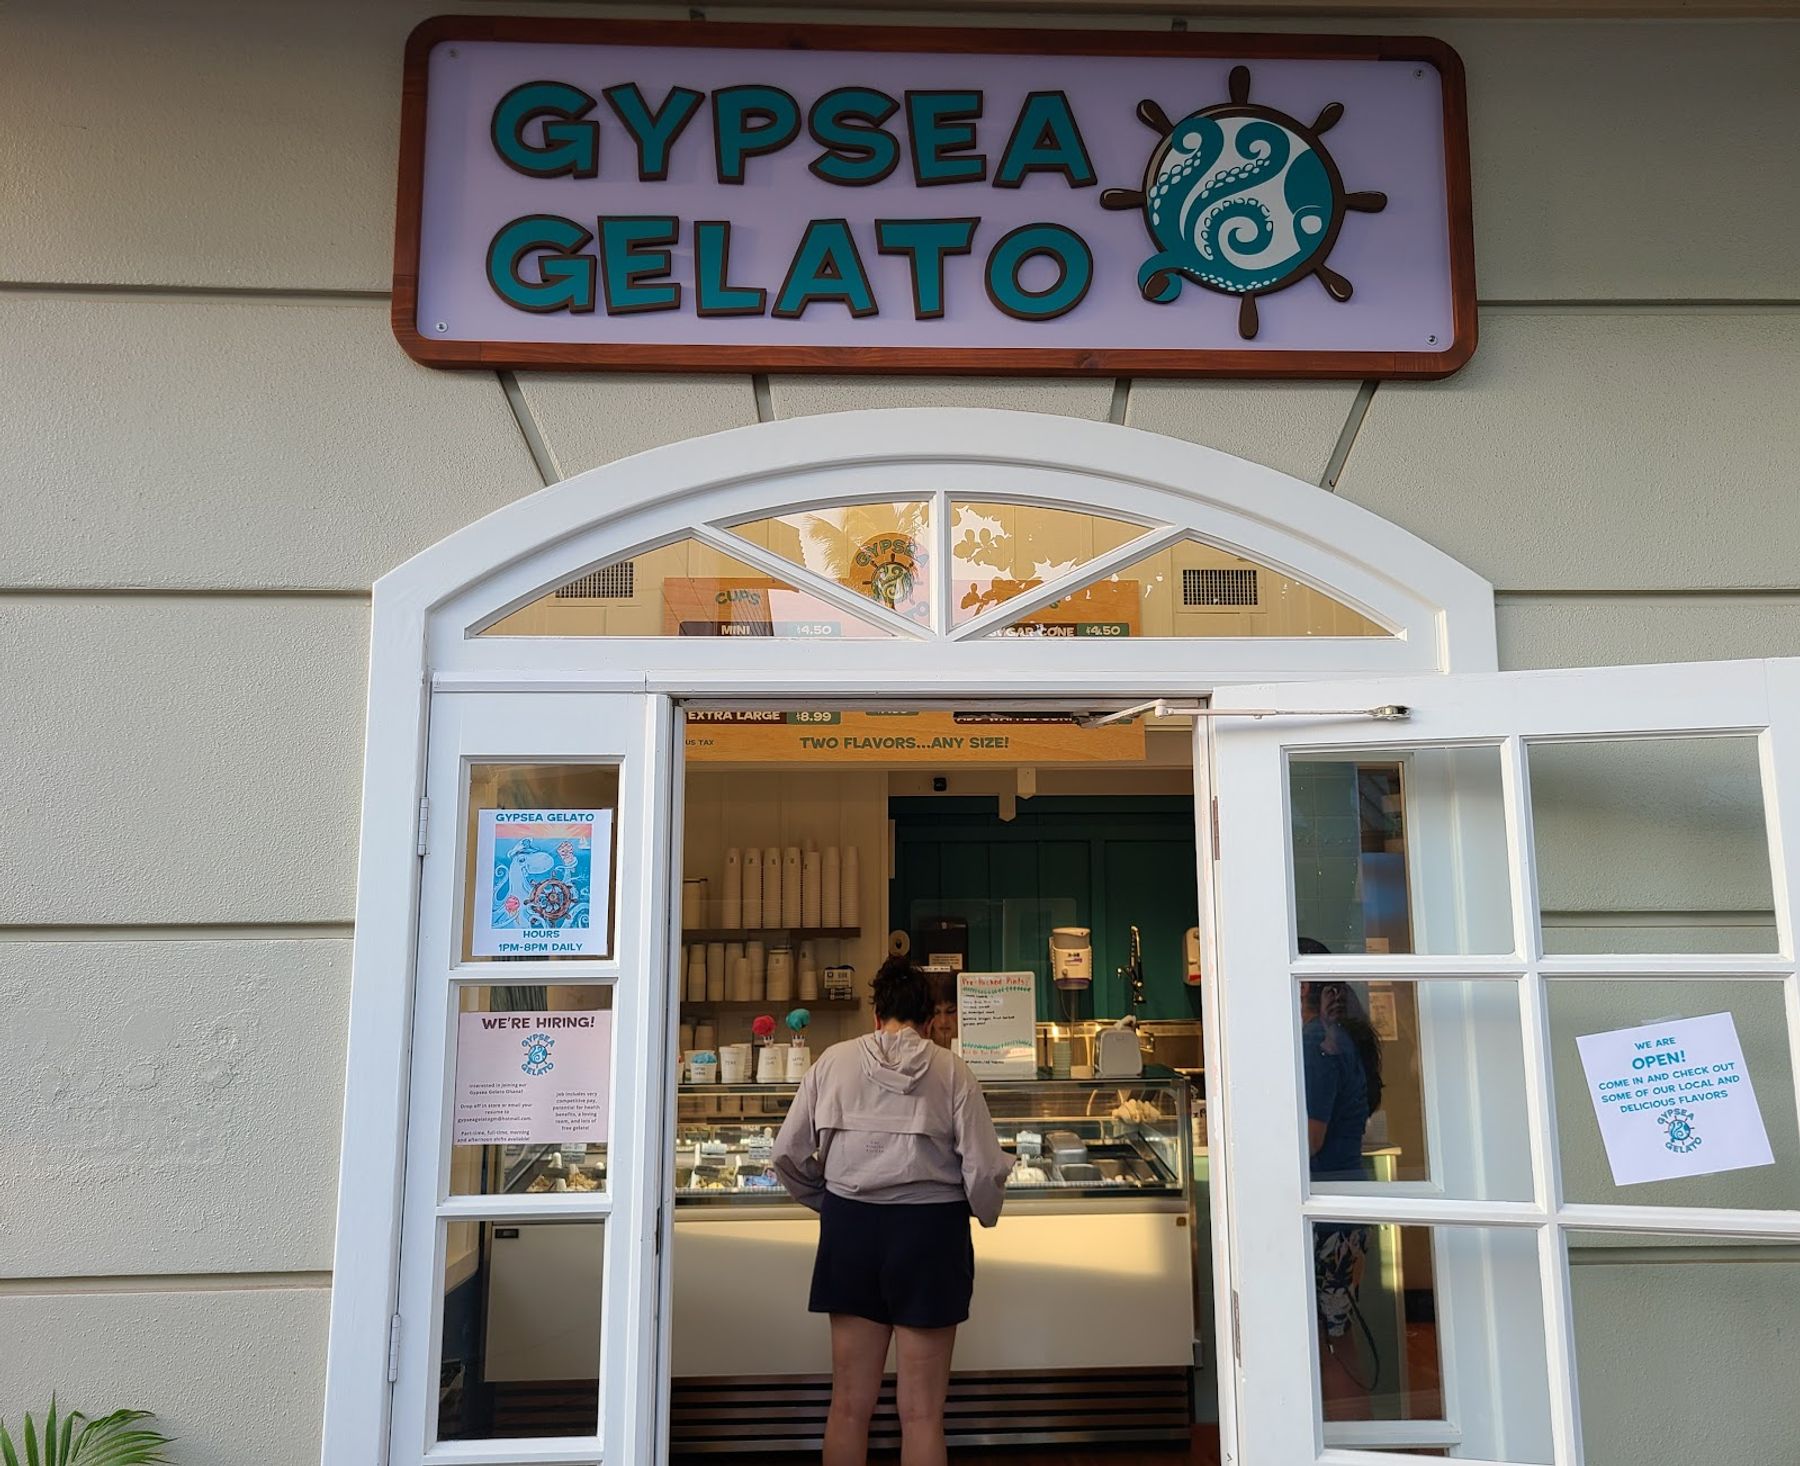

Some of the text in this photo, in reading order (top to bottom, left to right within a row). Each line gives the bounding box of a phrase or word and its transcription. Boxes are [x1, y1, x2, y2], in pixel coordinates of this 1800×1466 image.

[491, 80, 1097, 189] GYPSEA
[486, 214, 1094, 321] GELATO
[715, 590, 760, 606] CUPS
[721, 624, 751, 636] MINI
[1041, 626, 1075, 638] CONE
[1085, 625, 1121, 636] $4.50
[687, 710, 832, 722] EXTRA LARGE $8.99
[800, 736, 839, 749] TWO
[969, 736, 1009, 749] SIZE!
[495, 813, 594, 822] GYPSEA GELATO
[523, 930, 560, 939] HOURS
[498, 942, 583, 952] 1PM-8PM DAILY
[482, 1016, 595, 1029] WE'RE HIRING!
[521, 1033, 556, 1048] GYPSEA
[1635, 1037, 1676, 1050] WE ARE
[1632, 1050, 1686, 1070] OPEN!
[521, 1062, 554, 1076] GELATO
[1598, 1062, 1735, 1090] COME IN AND CHECK OUT
[1601, 1075, 1740, 1103] SOME OF OUR LOCAL AND
[1620, 1090, 1728, 1113] DELICIOUS FLAVORS
[1657, 1108, 1695, 1125] GYPSEA
[1665, 1136, 1702, 1153] GELATO
